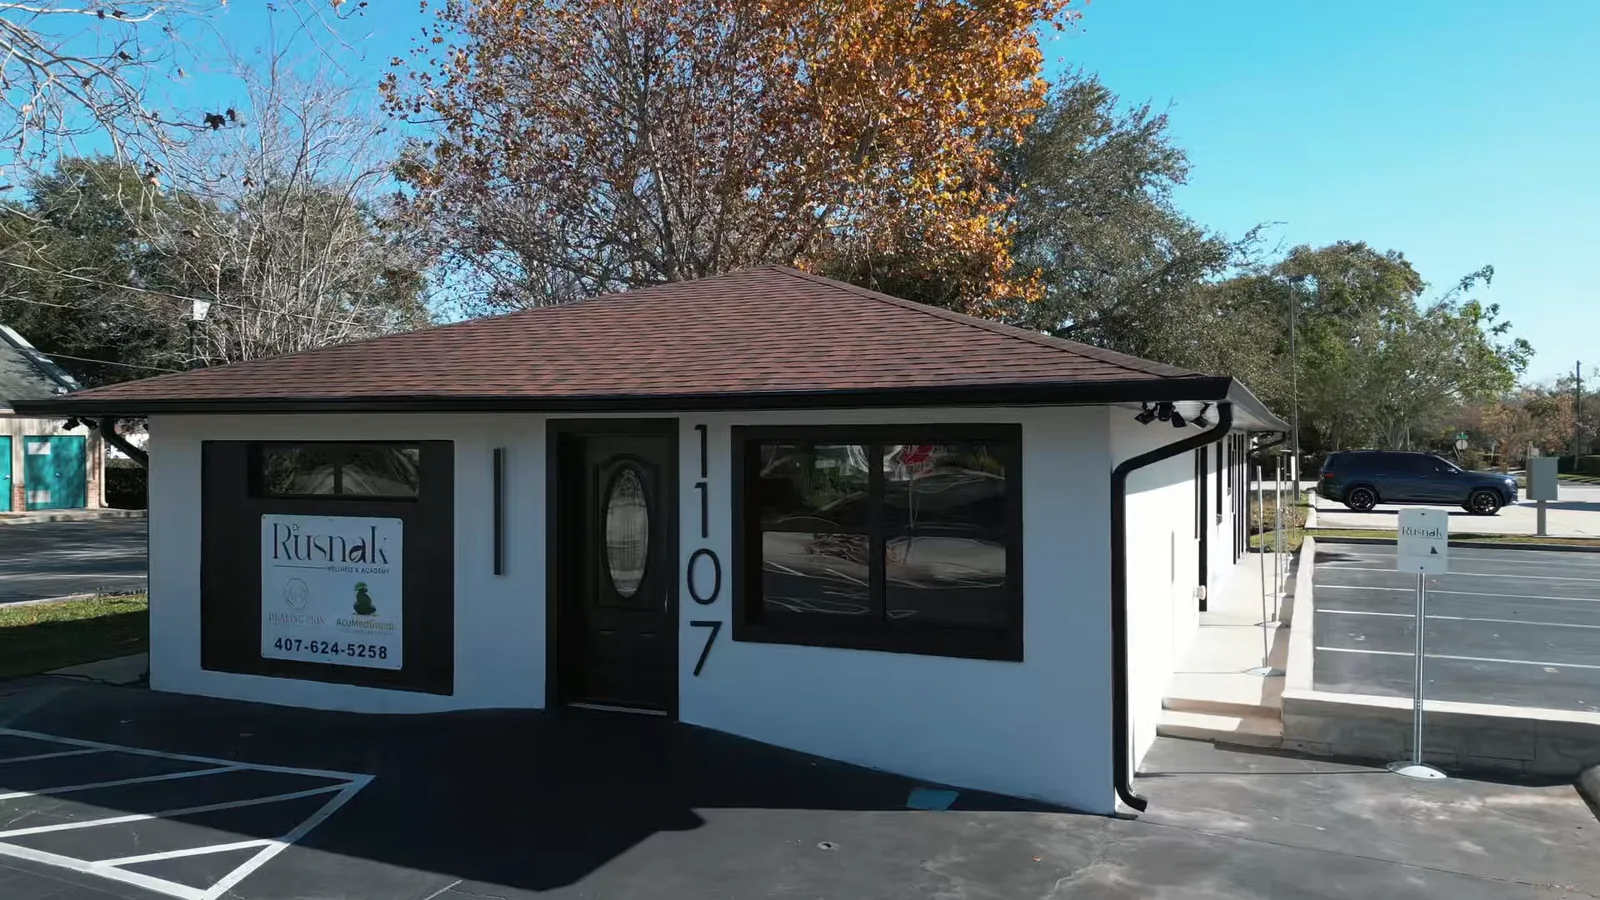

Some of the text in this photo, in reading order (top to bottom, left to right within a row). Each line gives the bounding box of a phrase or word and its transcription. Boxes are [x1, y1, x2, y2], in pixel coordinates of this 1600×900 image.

[273, 522, 389, 565] Rusnak
[1402, 526, 1442, 538] Rusnak
[686, 423, 723, 677] 1107
[336, 618, 394, 630] AcuMedGroup
[274, 637, 388, 660] 407-624-5258
